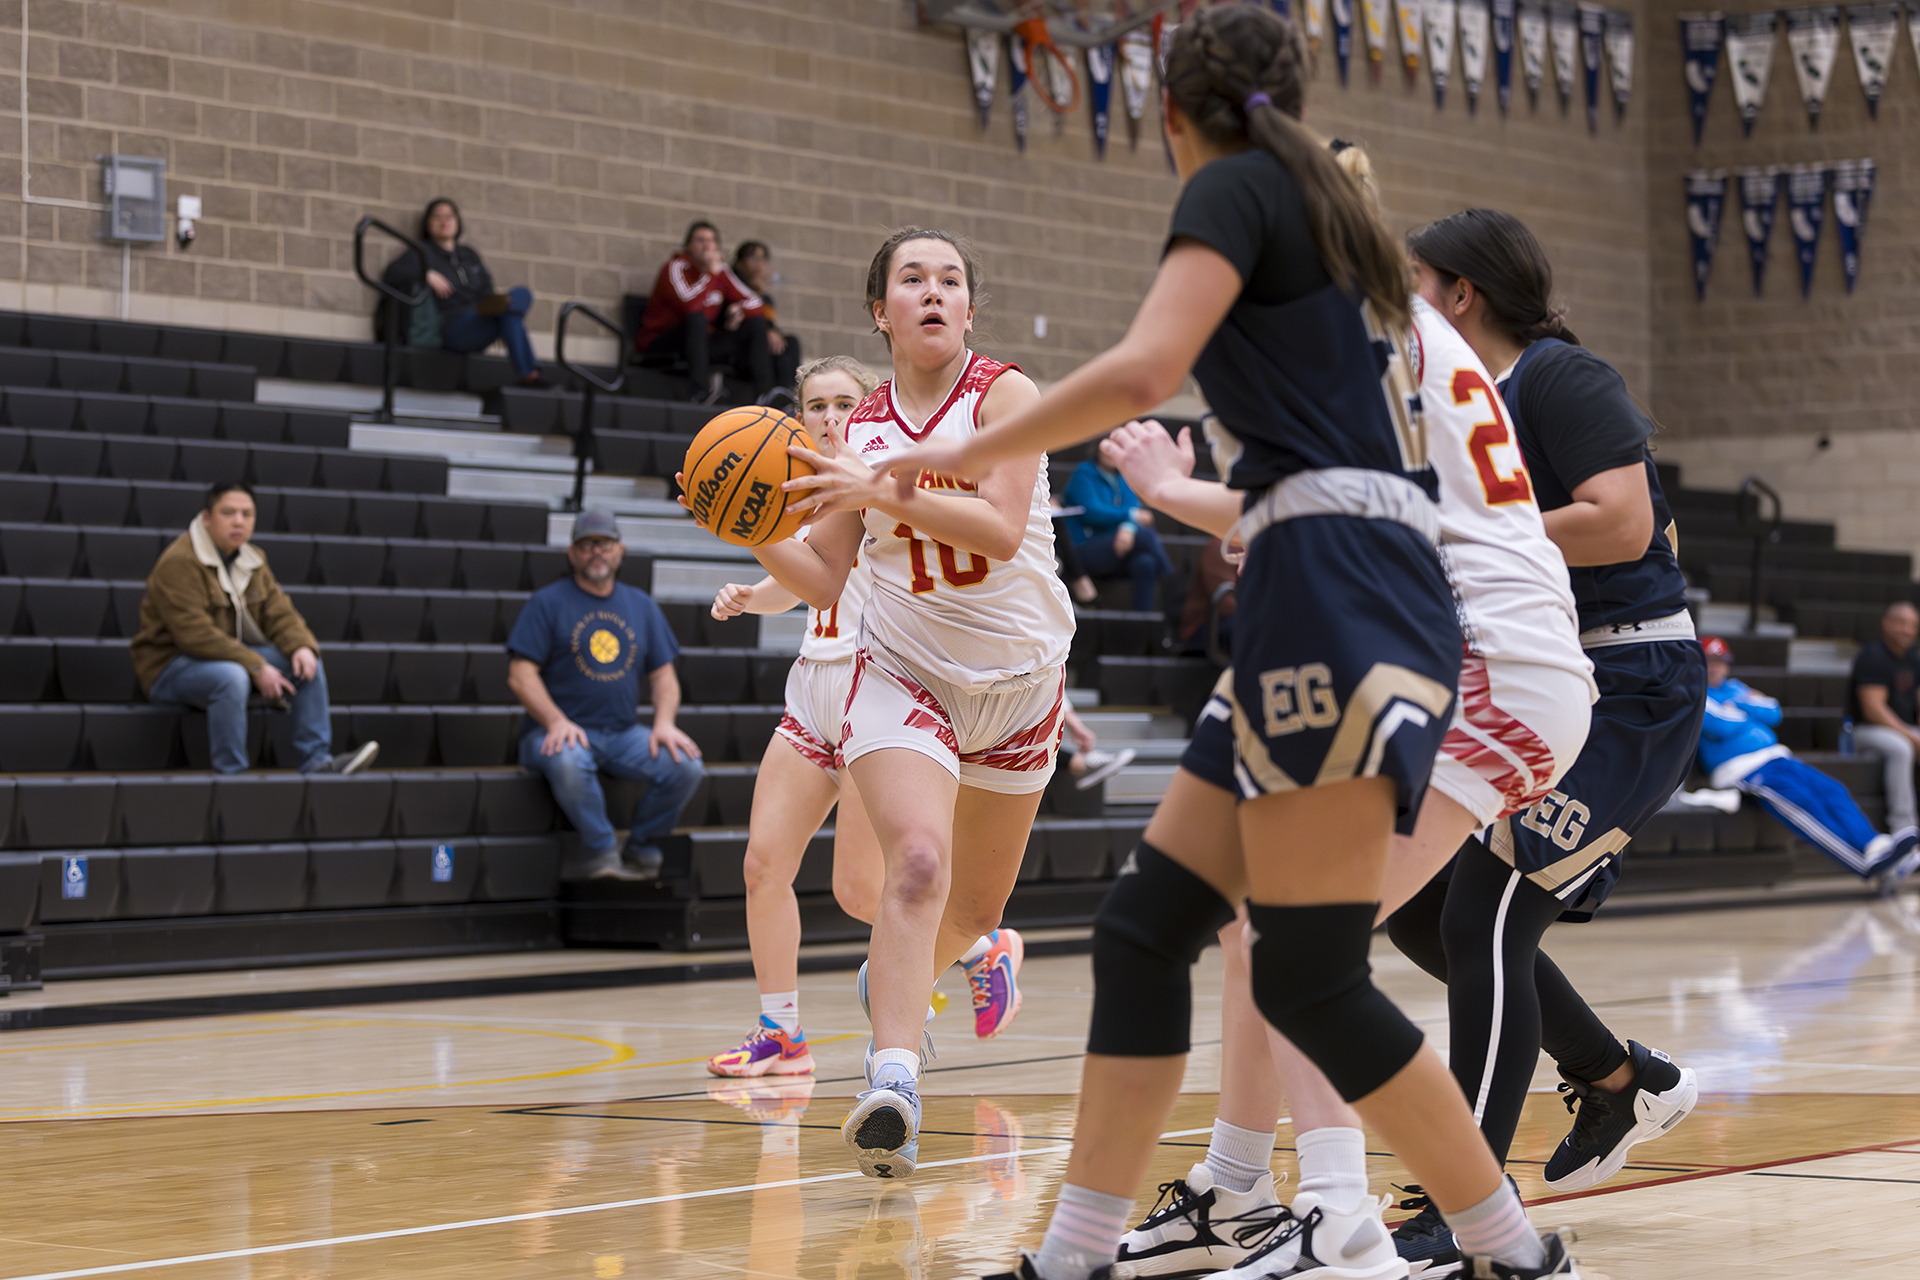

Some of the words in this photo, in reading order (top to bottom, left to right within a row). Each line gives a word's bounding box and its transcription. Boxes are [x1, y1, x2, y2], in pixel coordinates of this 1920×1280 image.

[862, 444, 889, 454] adidas
[693, 450, 744, 525] Wilson
[730, 480, 773, 540] NCAA
[892, 522, 990, 595] 10
[1259, 661, 1341, 738] EG
[1520, 789, 1591, 851] EG
